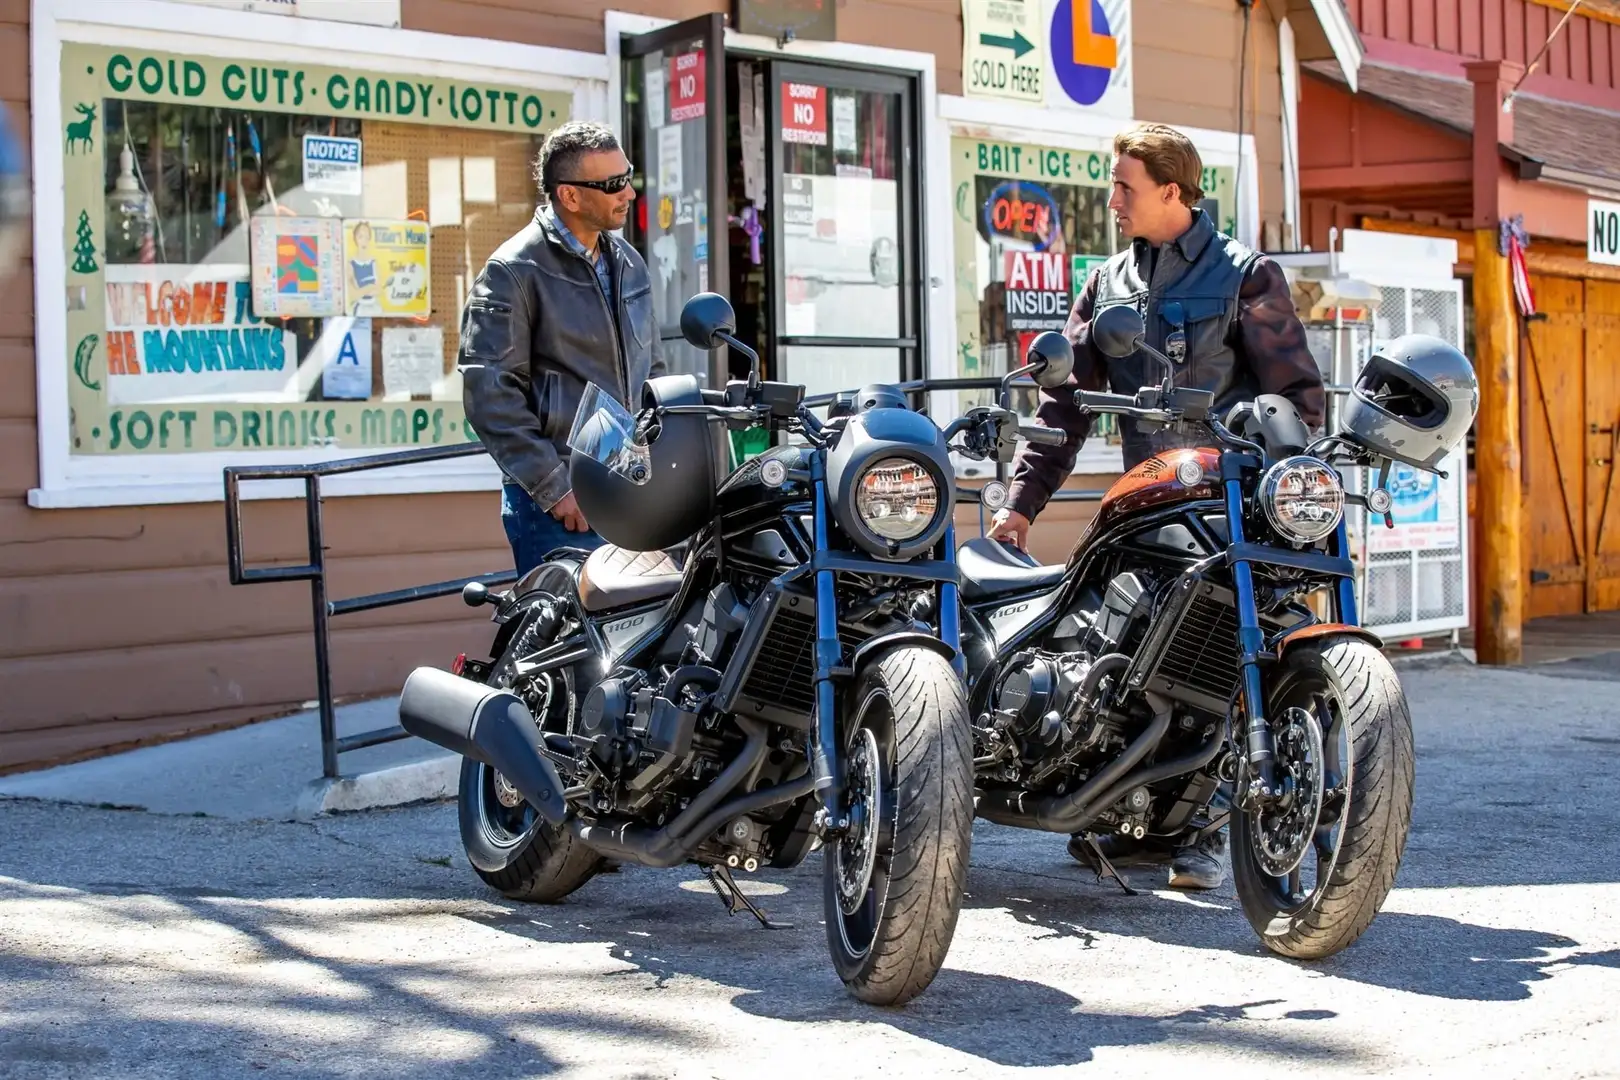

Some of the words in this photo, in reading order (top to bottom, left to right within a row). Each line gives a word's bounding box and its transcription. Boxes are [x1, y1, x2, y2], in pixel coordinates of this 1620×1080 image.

[107, 54, 206, 97] COLD
[222, 64, 305, 106] CUTS
[326, 74, 434, 118] CANDY
[449, 85, 542, 128] LOTTO
[680, 74, 696, 99] NO
[788, 83, 818, 99] SORRY
[972, 58, 1007, 89] SOLD
[1010, 64, 1040, 94] HERE
[793, 103, 815, 125] NO
[308, 140, 358, 161] NOTICE
[782, 128, 827, 145] RESTROOM
[977, 143, 1021, 173] BAIT
[1040, 150, 1071, 178] ICE
[1087, 154, 1113, 181] CA
[992, 197, 1050, 233] OPEN
[1594, 209, 1619, 255] NO
[1009, 251, 1065, 291] ATM
[106, 280, 228, 327] WELCOME
[1006, 290, 1069, 315] INSIDE
[143, 327, 286, 374] MOUNTAINS
[336, 332, 359, 366] A
[109, 410, 197, 450] SOFT
[213, 409, 336, 447] DRINKS
[360, 408, 444, 445] MAPS
